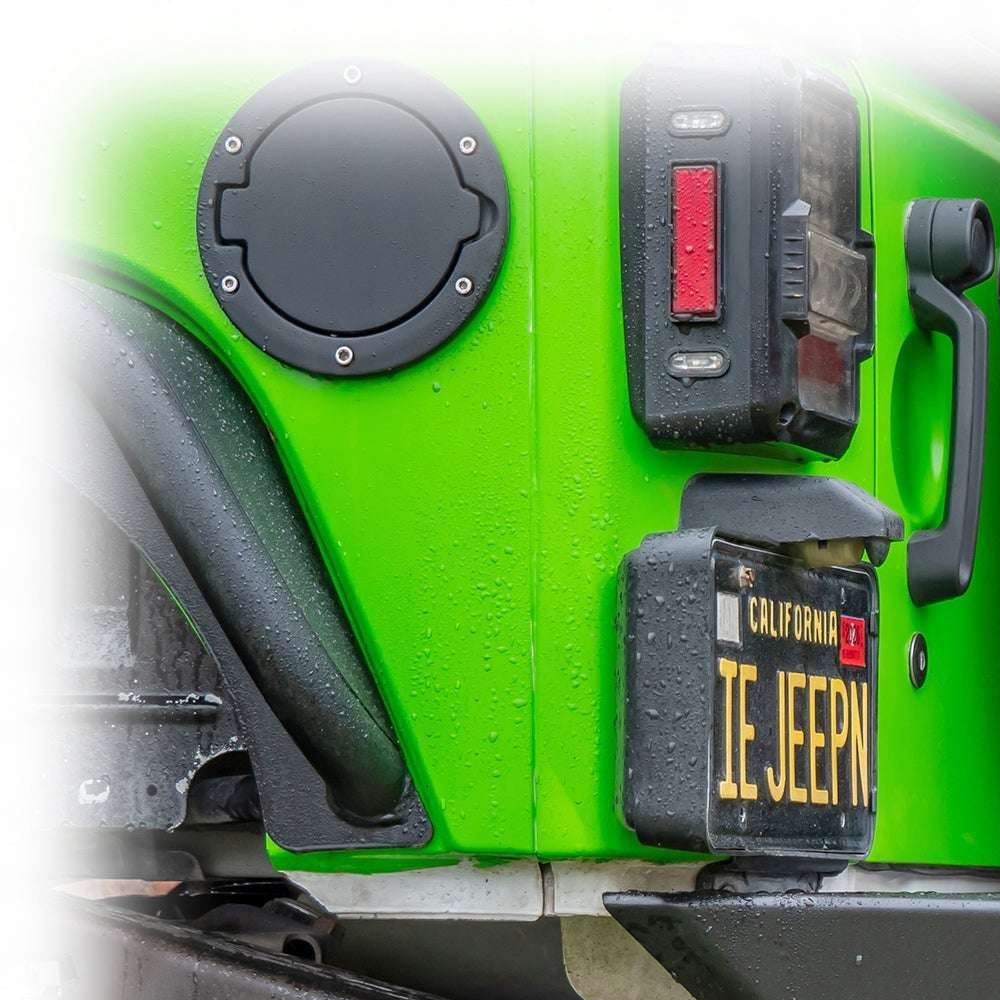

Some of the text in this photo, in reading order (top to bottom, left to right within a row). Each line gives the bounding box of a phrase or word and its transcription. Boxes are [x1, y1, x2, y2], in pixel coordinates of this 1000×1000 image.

[749, 597, 838, 646] CALIFORNIA
[719, 657, 869, 808] IE JEEPN
